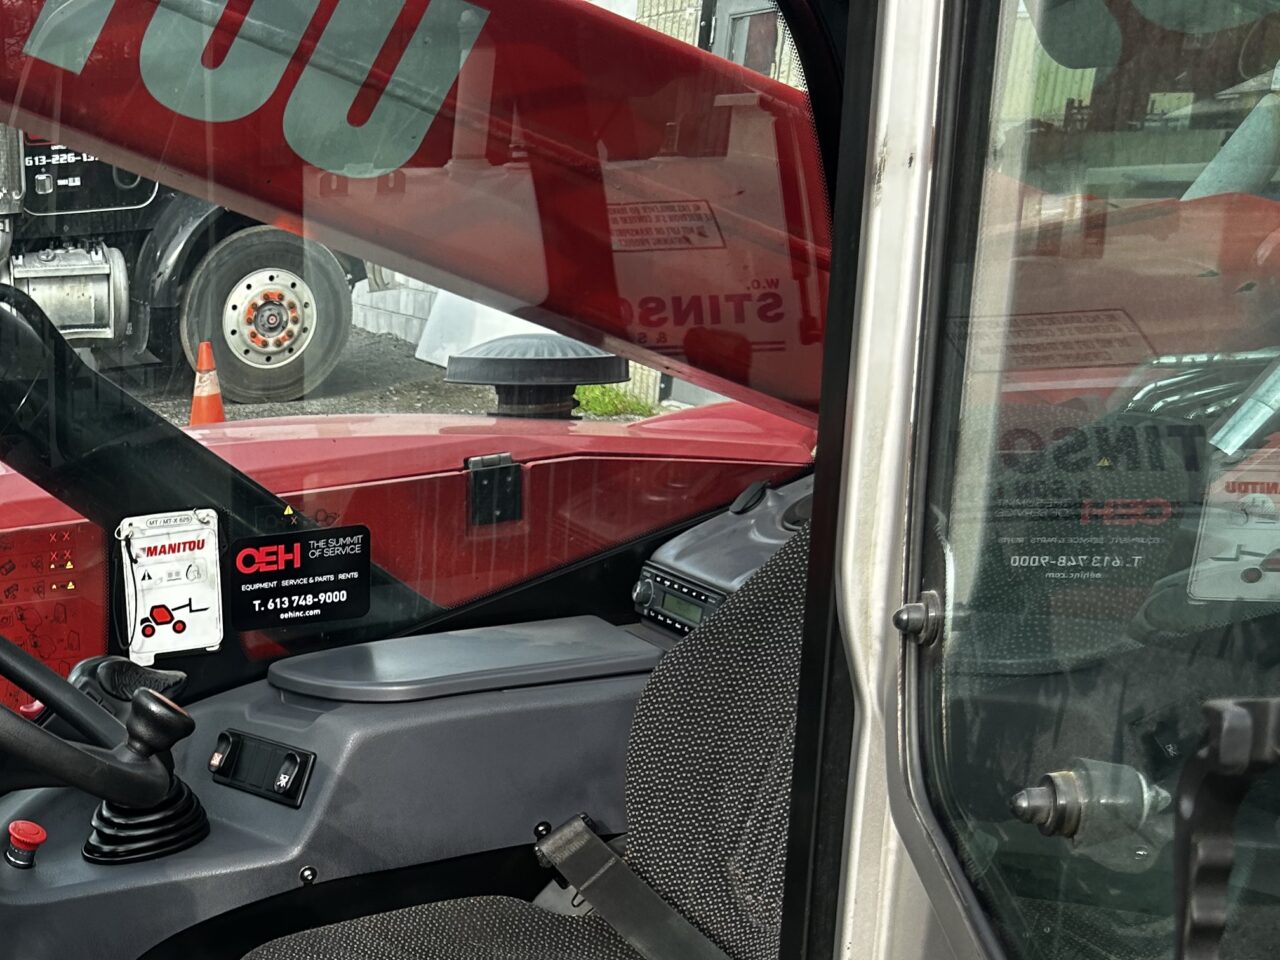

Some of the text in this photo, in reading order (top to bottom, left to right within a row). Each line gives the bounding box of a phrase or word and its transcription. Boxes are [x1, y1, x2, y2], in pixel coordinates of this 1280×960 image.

[146, 539, 205, 557] MANITOU
[308, 535, 363, 549] THE SUMMIT
[236, 543, 300, 574] OEH
[308, 544, 362, 559] OF SERVICE
[241, 580, 277, 591] EQUIPMENT
[281, 577, 308, 587] SERVICE
[314, 574, 334, 583] PARTS
[338, 572, 359, 580] RENTS
[252, 590, 348, 612] T. 613 748-9000
[280, 608, 321, 620] oehinc.com
